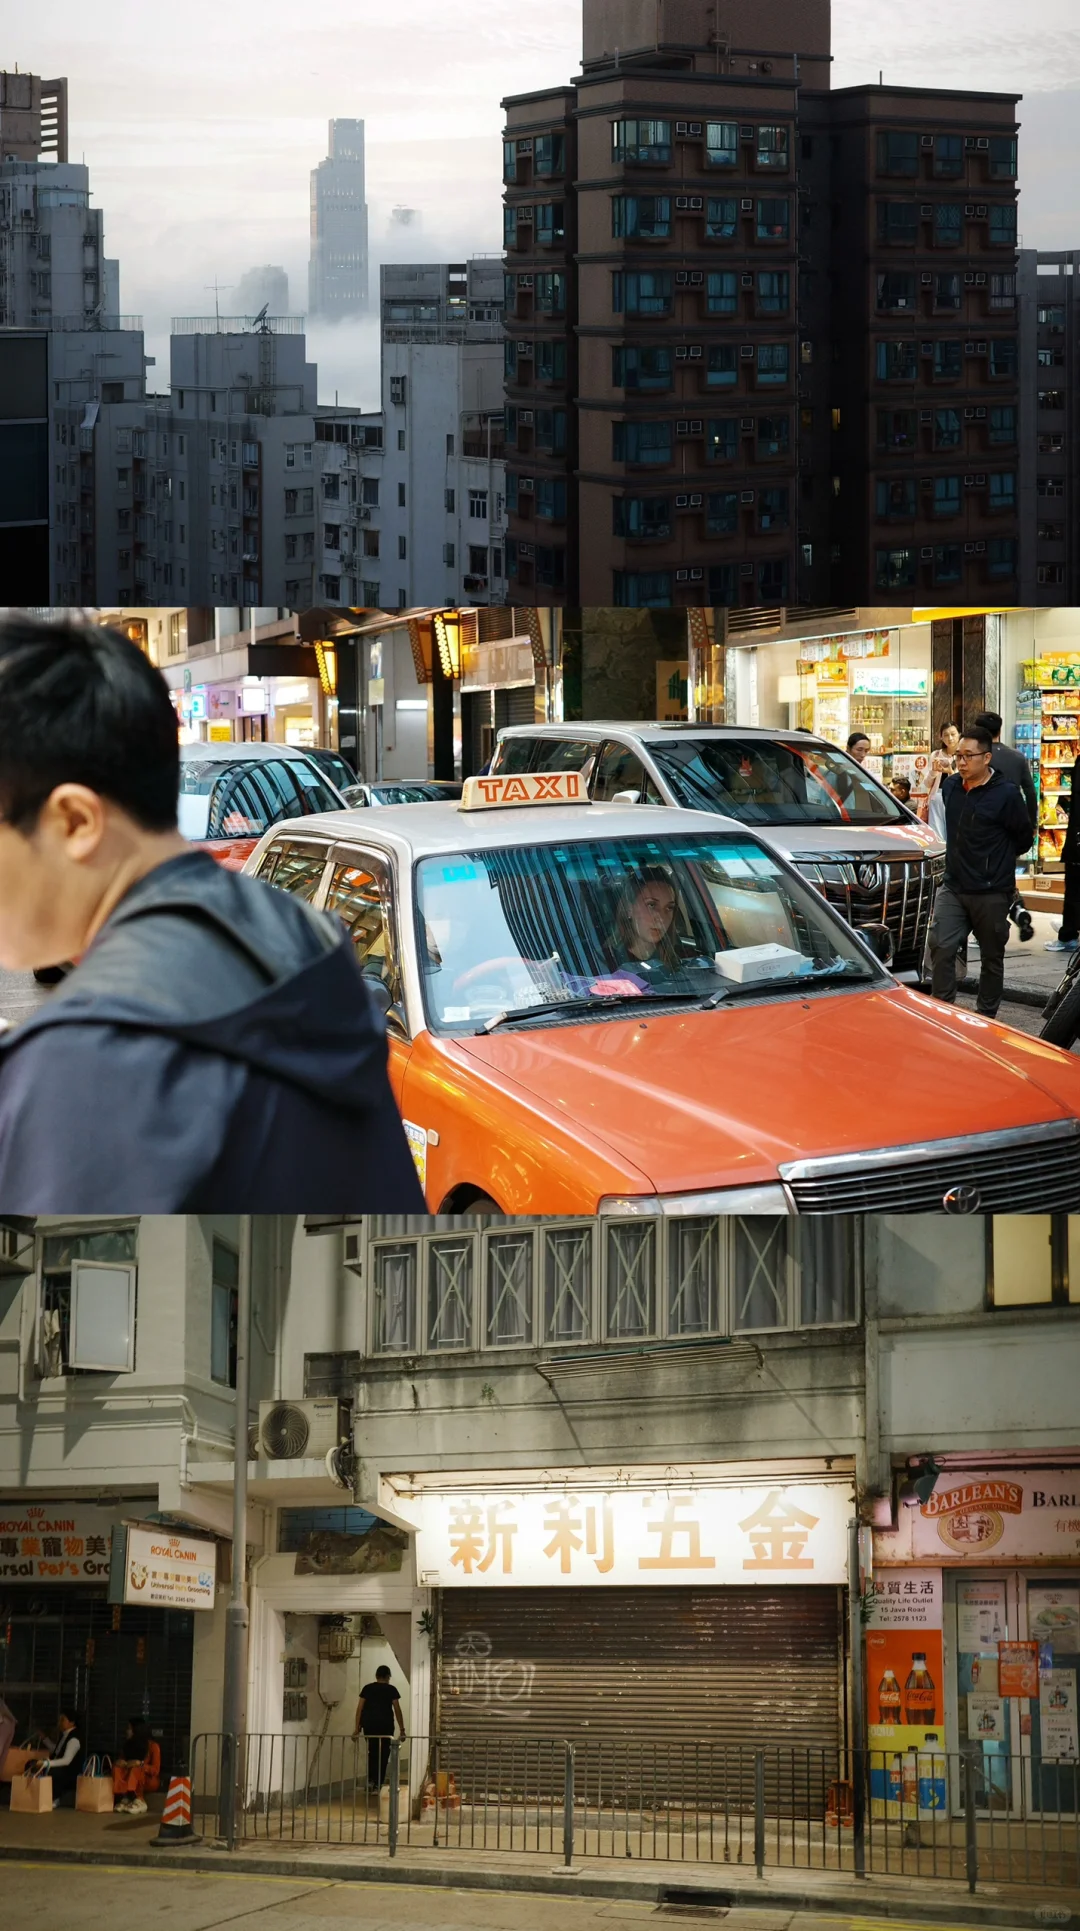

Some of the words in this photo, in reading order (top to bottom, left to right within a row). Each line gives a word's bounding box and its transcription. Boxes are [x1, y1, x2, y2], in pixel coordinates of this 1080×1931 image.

[477, 774, 580, 803] TAXI
[925, 1482, 1019, 1515] BARLEAN'S
[0, 1521, 35, 1533] ROYAL
[37, 1520, 75, 1532] CANIN
[448, 1490, 820, 1575] 新利五金
[0, 1535, 111, 1558] 專業寵物美
[151, 1545, 173, 1558] ROYAL
[174, 1549, 197, 1561] CANIN
[38, 1560, 80, 1577] Pet's
[871, 1580, 934, 1595] 優質生活
[872, 1598, 896, 1606] Quality
